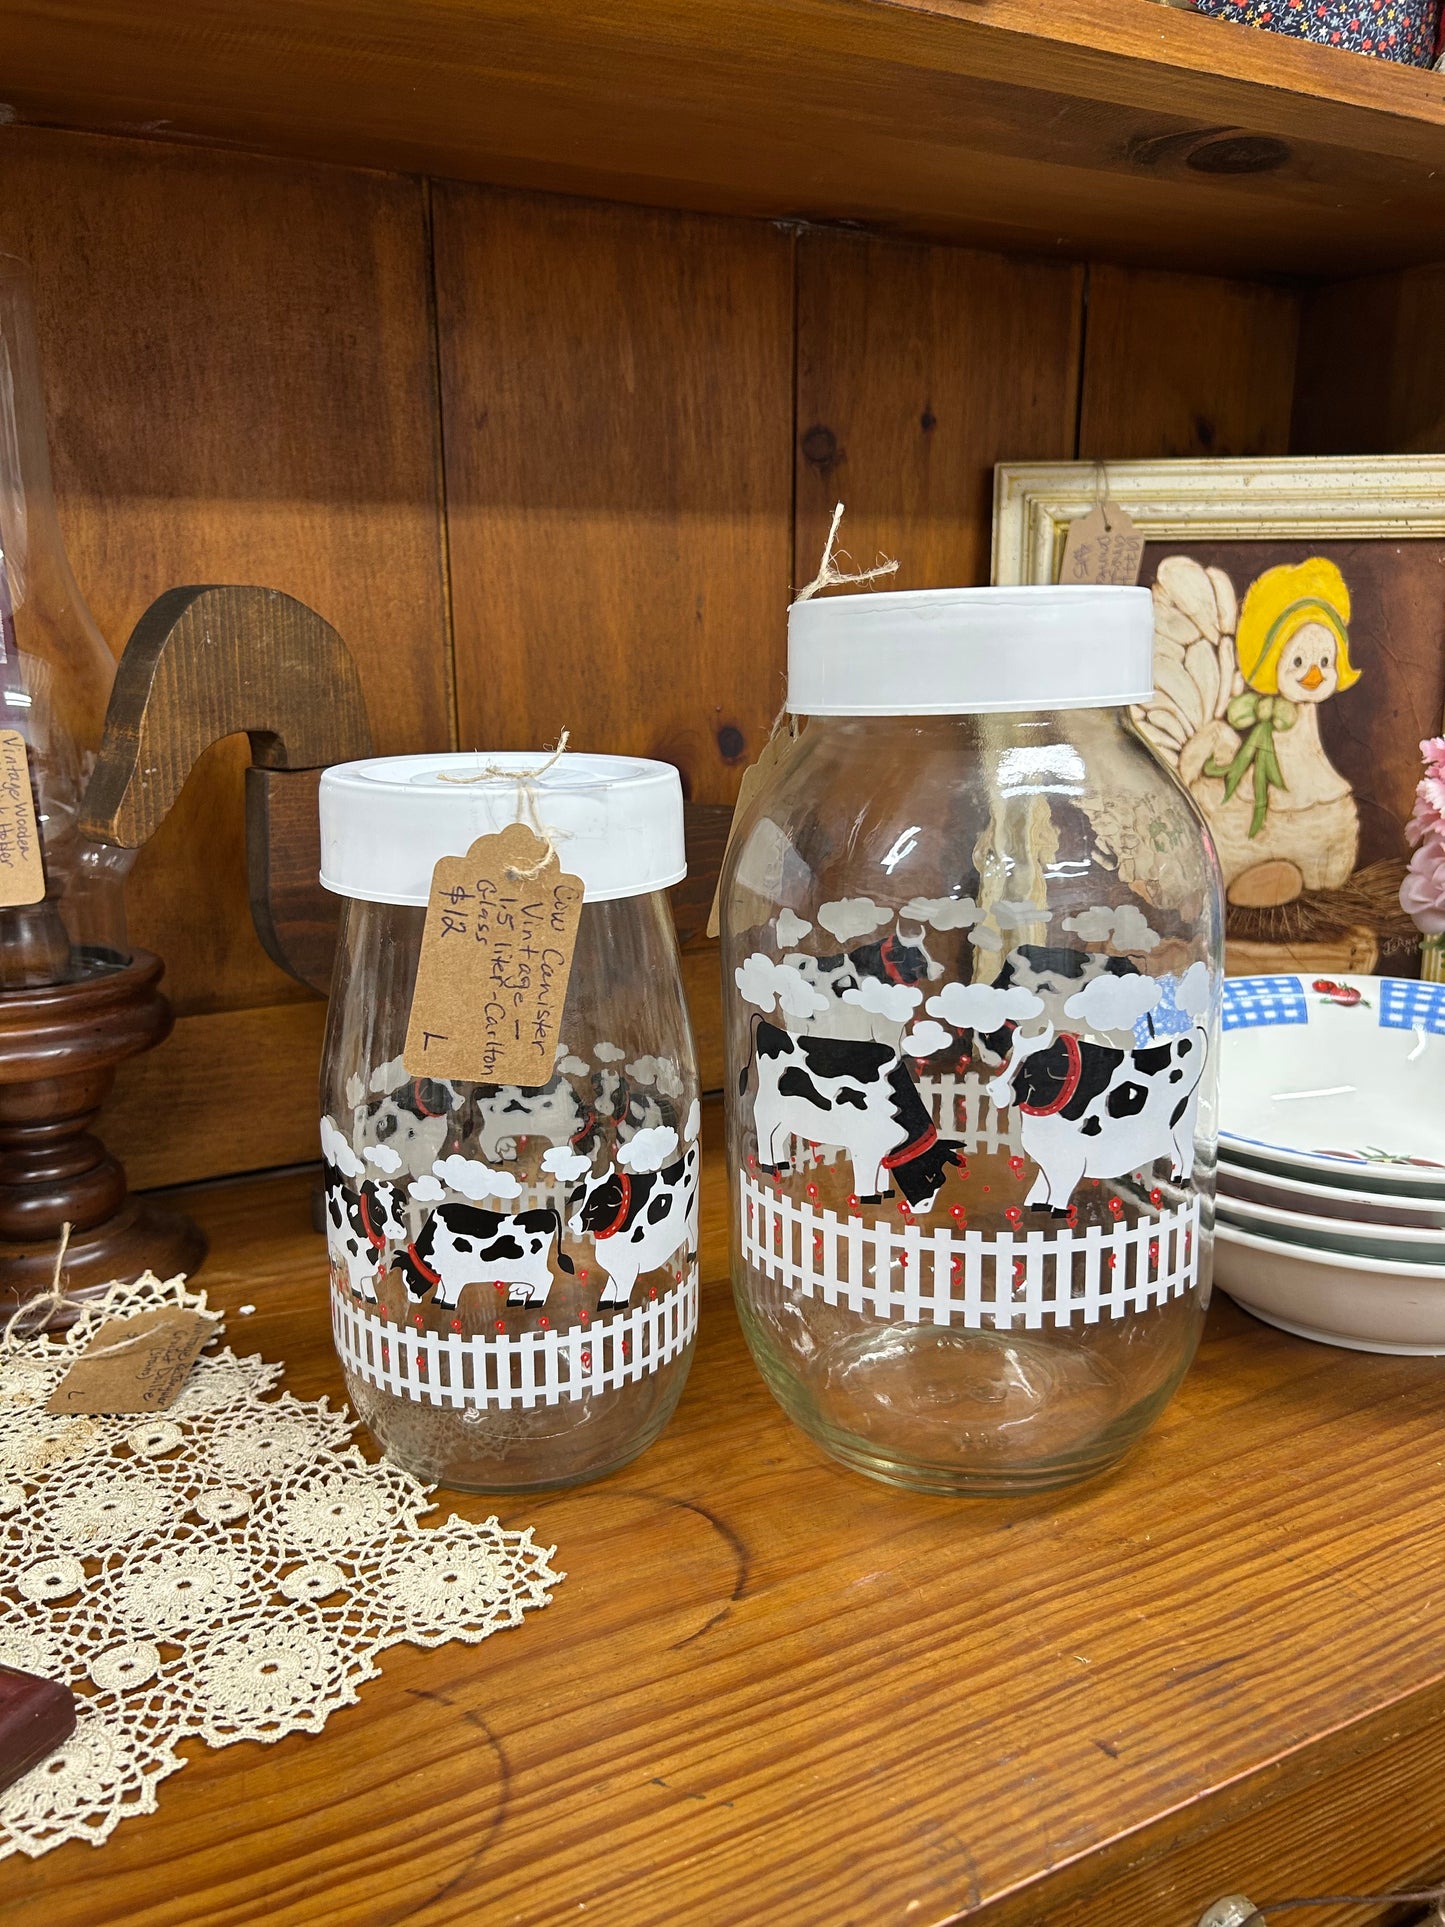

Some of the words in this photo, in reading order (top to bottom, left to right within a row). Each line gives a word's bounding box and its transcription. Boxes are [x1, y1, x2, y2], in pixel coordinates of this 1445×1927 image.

[2, 736, 24, 800] Vintage
[14, 802, 32, 862] Wooden
[438, 886, 476, 938] $12
[475, 879, 498, 945] Glass
[497, 898, 518, 931] 1.5
[551, 884, 580, 931] Cow
[503, 902, 544, 1007] Vintage
[532, 948, 565, 1056] Canister
[422, 1031, 449, 1052] L
